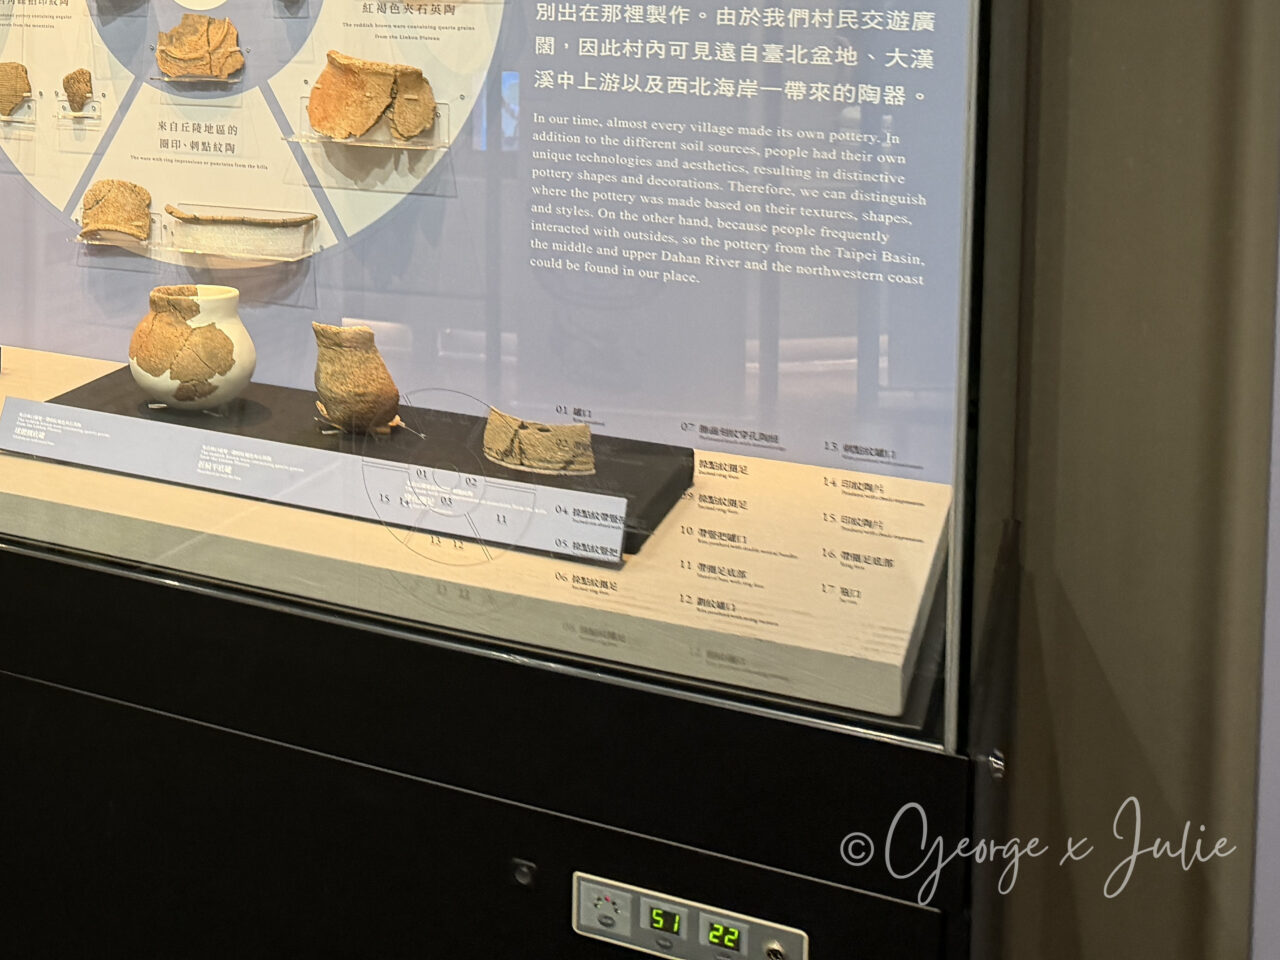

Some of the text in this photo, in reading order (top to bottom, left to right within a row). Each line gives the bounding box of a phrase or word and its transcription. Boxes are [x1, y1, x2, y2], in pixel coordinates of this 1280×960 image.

[534, 70, 926, 106] 溪中上游以及西北海岸一帶來的陶器。
[533, 112, 899, 146] In our time, almost every village made its own pottery. In
[532, 131, 905, 164] addition to the different soil sources, people had their own
[532, 169, 926, 206] pottery shapes and decorations. Therefore, we can distinguish
[530, 203, 888, 245] and styles. On the other hand, because people frequently
[531, 220, 927, 266] interacted with outsides, so the pottery from the Taipei Basin,
[529, 257, 701, 283] could be found in our place.
[530, 238, 923, 285] the middle and upper Dahan River and the northwestern coast
[652, 909, 680, 932] 51
[709, 924, 739, 947] 22
